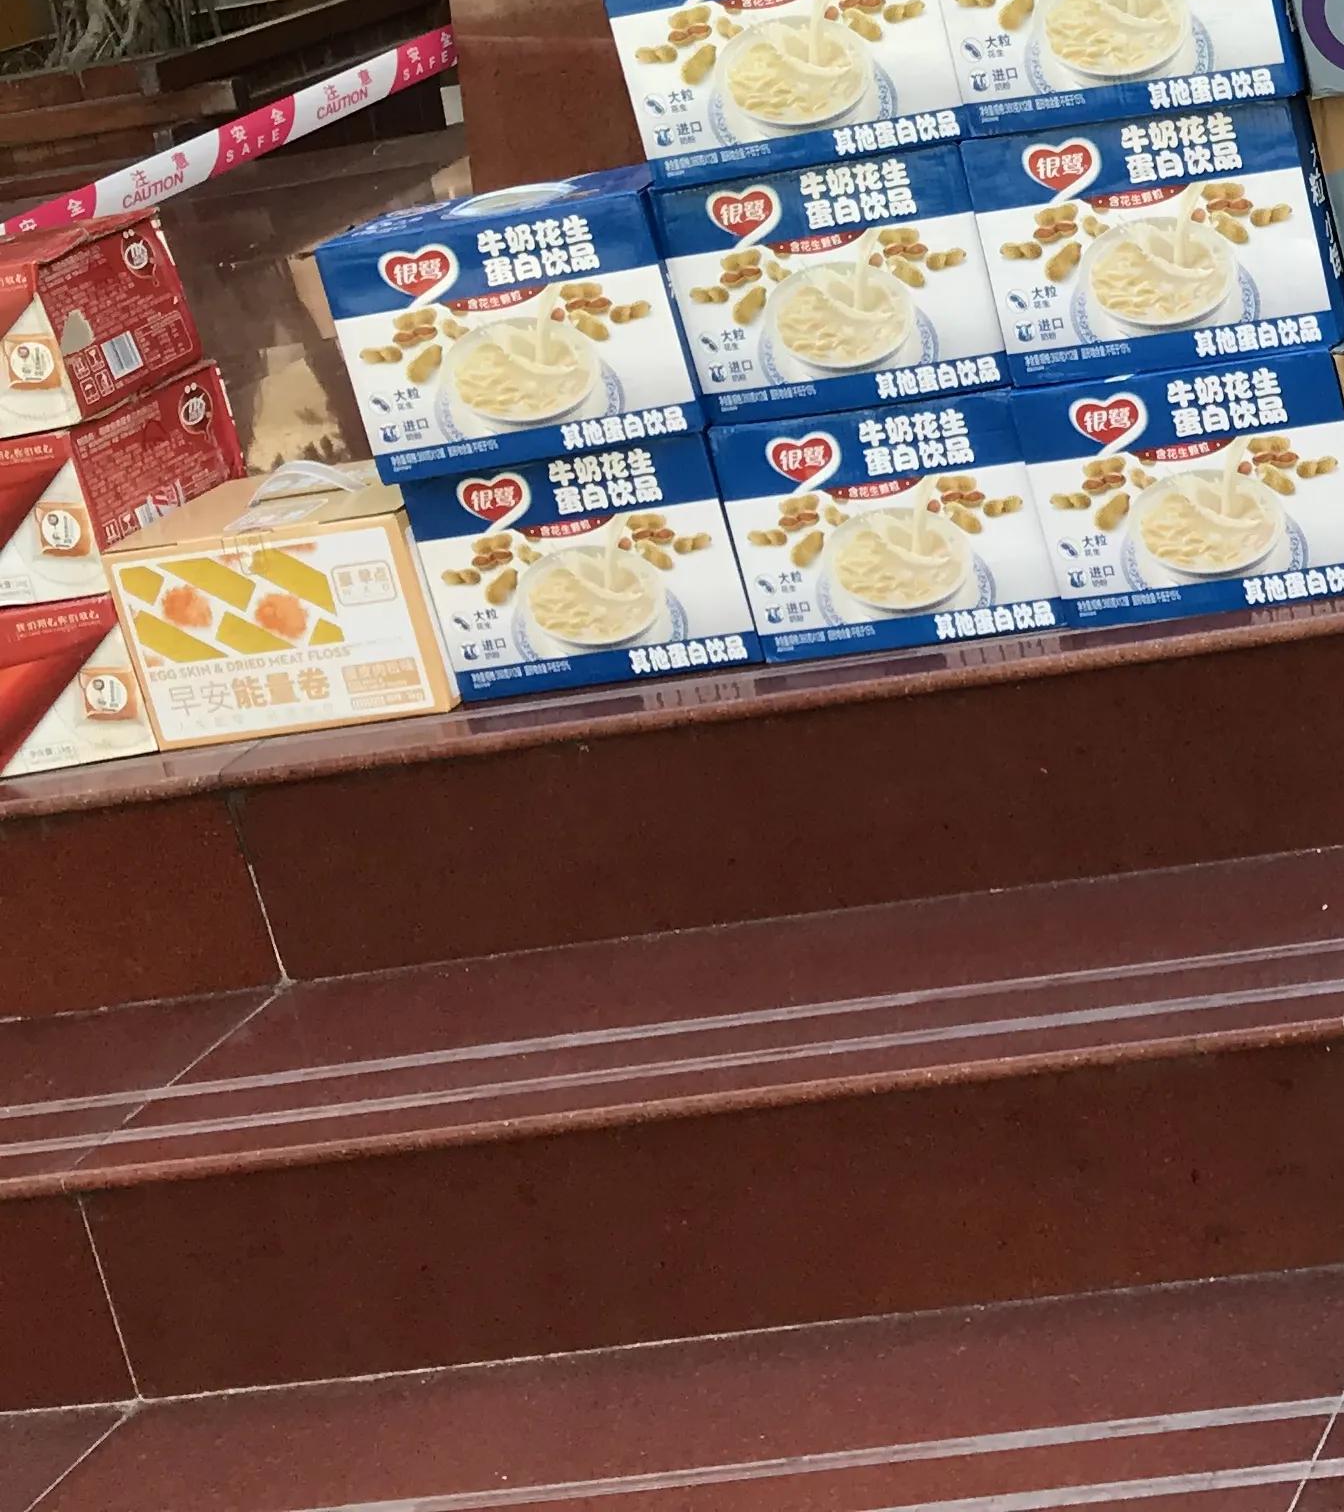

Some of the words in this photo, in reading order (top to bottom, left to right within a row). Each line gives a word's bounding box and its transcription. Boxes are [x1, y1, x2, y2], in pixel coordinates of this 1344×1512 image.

[407, 31, 453, 63] 安全
[986, 34, 1012, 48] 大粒
[403, 52, 449, 81] SAFE
[992, 68, 1018, 82] 进口
[323, 69, 373, 101] 注意
[669, 88, 695, 103] 大粒
[1148, 69, 1275, 110] 其他蛋白饮品
[316, 87, 369, 120] CAUTION
[230, 108, 286, 144] 安全
[676, 121, 702, 136] 进口
[833, 111, 960, 156] 其他蛋白饮品
[1121, 112, 1236, 153] 牛奶花生
[226, 129, 281, 163] SAFE
[1125, 141, 1242, 183] 蛋白饮品
[131, 151, 190, 188] 注意
[799, 158, 910, 199] 牛奶花生
[122, 171, 184, 209] CAUTION
[1109, 188, 1164, 207] 含花生颗粒
[804, 187, 916, 229] 蛋白饮品
[477, 215, 592, 257] 牛奶花生
[790, 234, 842, 252] 含花生颗粒
[482, 243, 599, 286] 蛋白饮品
[468, 290, 523, 309] 含花生颗粒
[1032, 285, 1057, 299] 大粒
[721, 329, 746, 342] 大粒
[1038, 318, 1064, 332] 进口
[1194, 316, 1321, 358] 其他蛋白饮品
[728, 360, 752, 374] 进口
[876, 359, 998, 399] 其他蛋白饮品
[394, 387, 421, 401] 大粒
[1167, 368, 1281, 407] 牛奶花生
[403, 418, 429, 433] 进口
[560, 407, 687, 451] 其他蛋白饮品
[858, 409, 968, 447] 牛奶花生
[1171, 396, 1287, 437] 蛋白饮品
[863, 437, 974, 475] 蛋白饮品
[1156, 441, 1210, 459] 含花生颗粒
[548, 448, 655, 486] 牛奶花生
[553, 476, 663, 514] 蛋白饮品
[849, 480, 901, 497] 含花生颗粒
[540, 519, 592, 536] 含花生颗粒
[1082, 534, 1108, 548] 大粒
[779, 571, 803, 584] 大粒
[1089, 566, 1114, 579] 进口
[474, 608, 498, 621] 大粒
[786, 601, 810, 615] 进口
[934, 602, 1055, 640] 其他蛋白饮品
[482, 638, 506, 652] 进口
[629, 636, 747, 674] 其他蛋白饮品
[150, 667, 177, 682] EGG
[179, 665, 211, 679] SKIN
[214, 663, 223, 674] &
[227, 658, 266, 673] DRIED
[268, 653, 304, 669] MEAT
[308, 645, 351, 660] FLOSS
